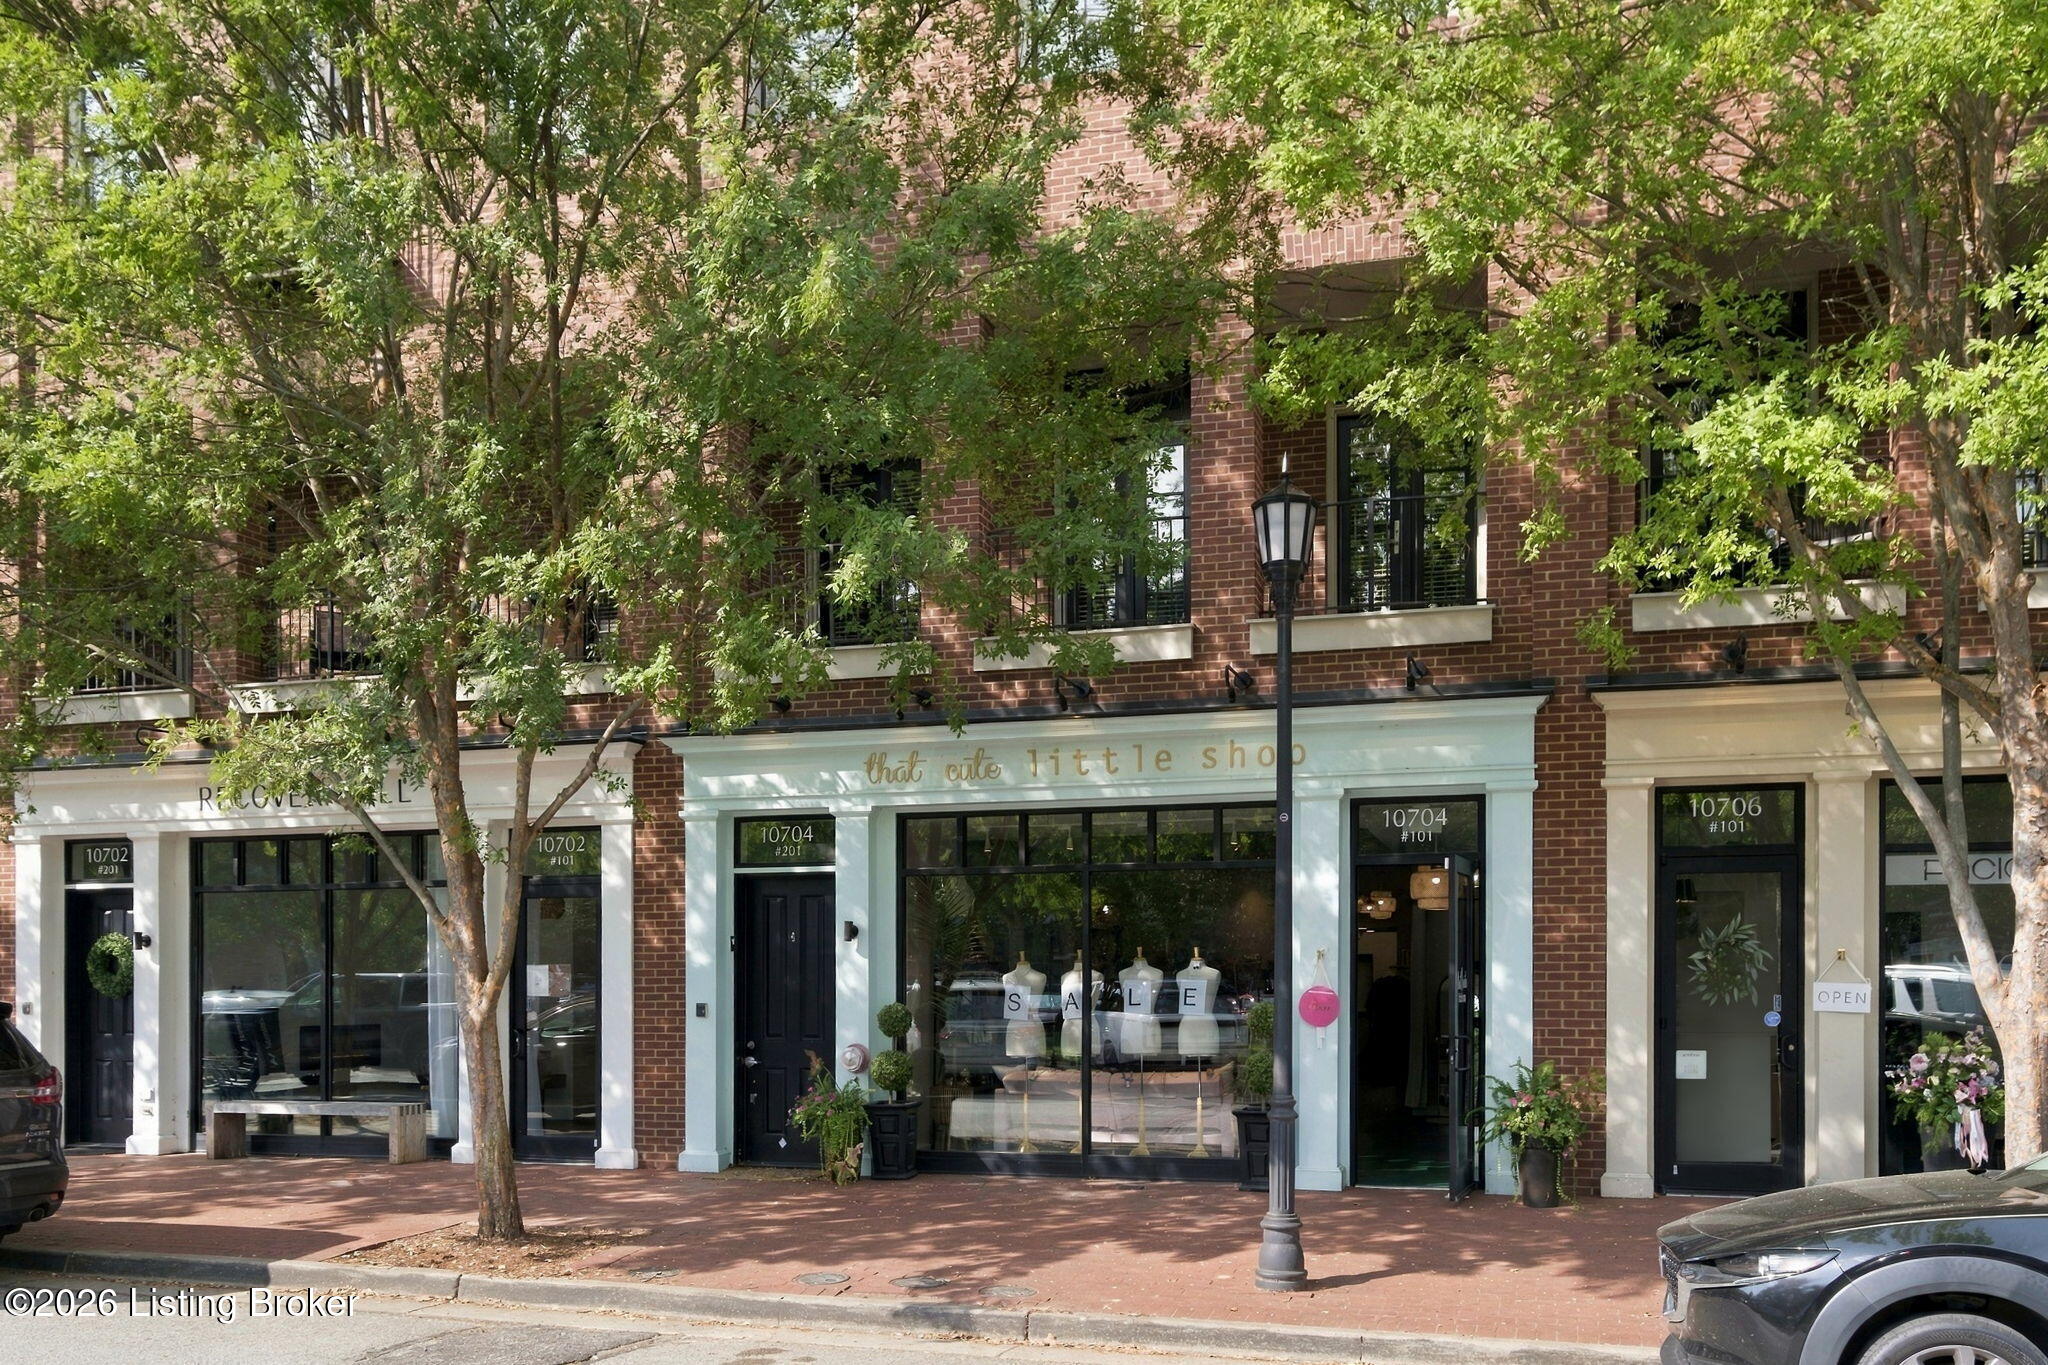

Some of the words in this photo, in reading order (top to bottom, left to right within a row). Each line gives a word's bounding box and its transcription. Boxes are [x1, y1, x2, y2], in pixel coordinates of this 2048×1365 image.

[864, 750, 927, 784] that
[945, 747, 1001, 782] cute
[1027, 743, 1172, 777] little
[1689, 796, 1762, 818] 10706
[1382, 807, 1448, 828] 10704
[1709, 819, 1744, 833] #101
[761, 825, 814, 843] 10704
[1400, 830, 1433, 843] #101
[535, 835, 586, 853] 10702
[775, 845, 801, 857] #201
[86, 847, 129, 863] 10702
[550, 855, 574, 866] #101
[97, 864, 119, 875] #201
[1817, 990, 1867, 1005] OPEN
